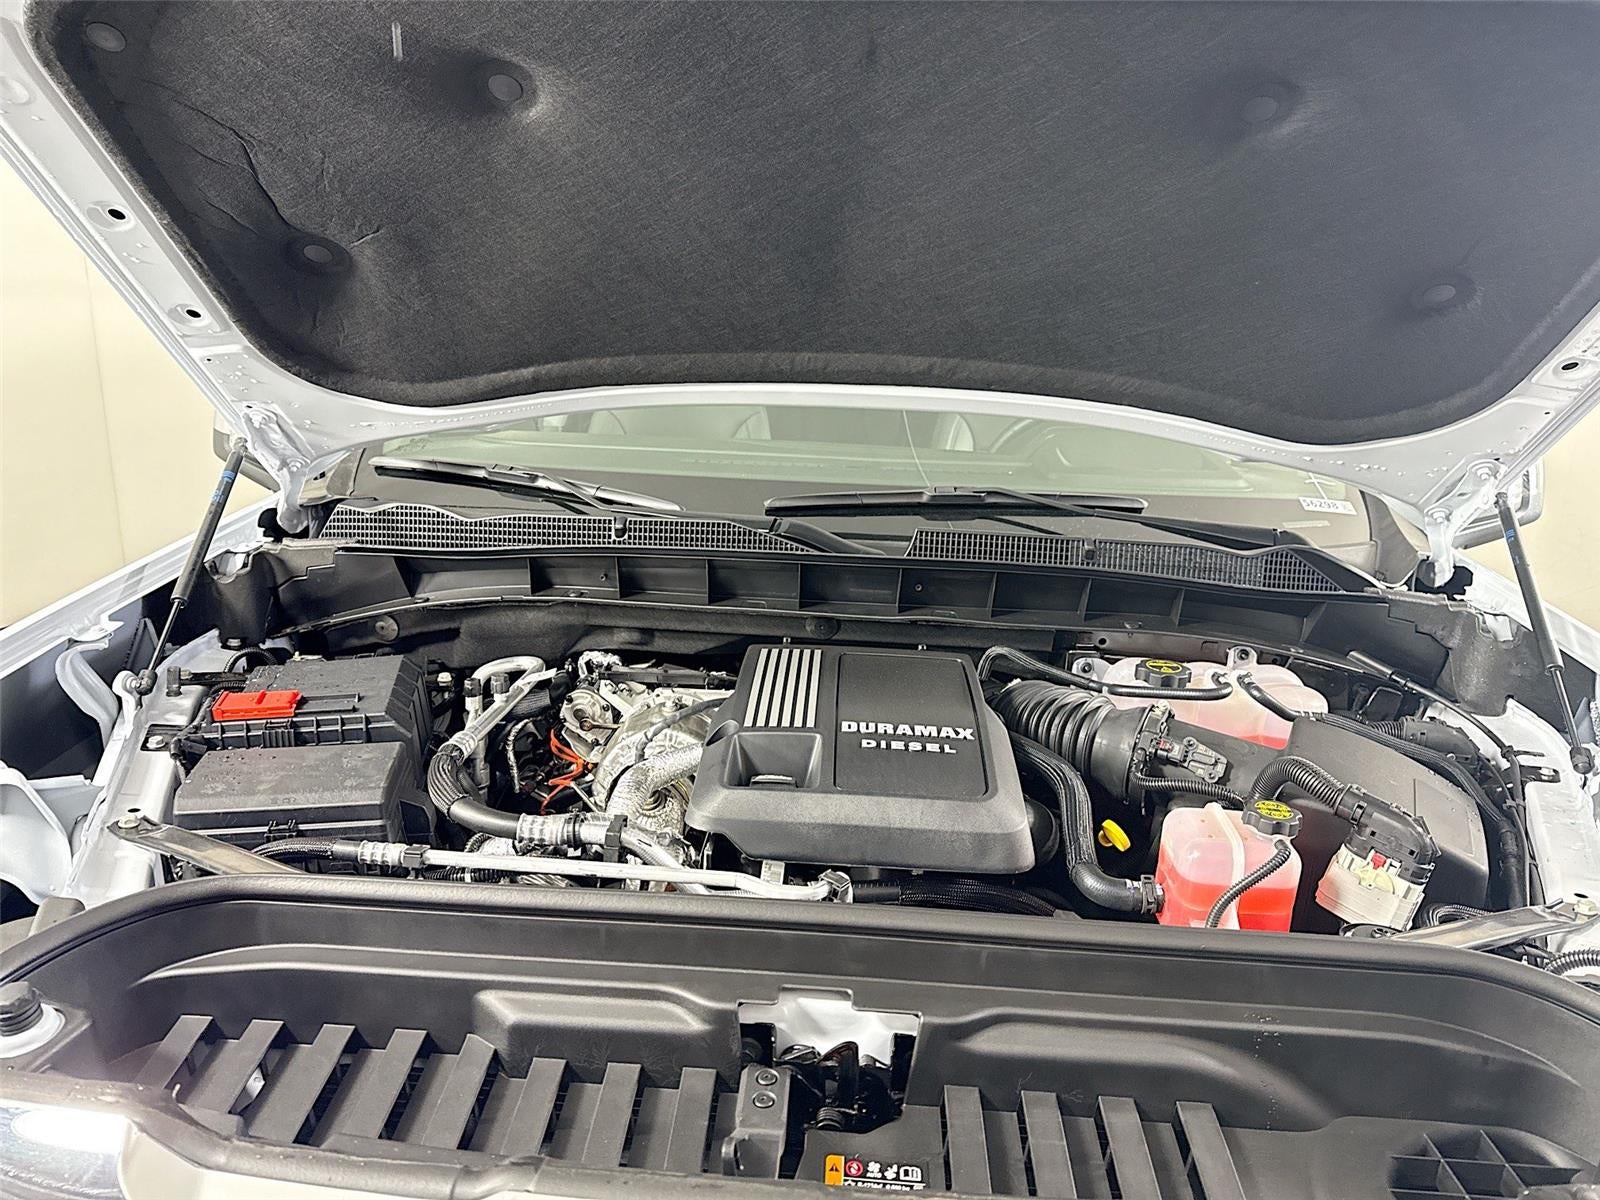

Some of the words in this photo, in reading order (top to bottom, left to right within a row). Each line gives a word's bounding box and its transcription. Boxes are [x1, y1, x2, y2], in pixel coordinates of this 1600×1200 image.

[1302, 499, 1339, 510] 56298
[841, 720, 976, 740] DURAMAX
[861, 738, 957, 754] DIESEL
